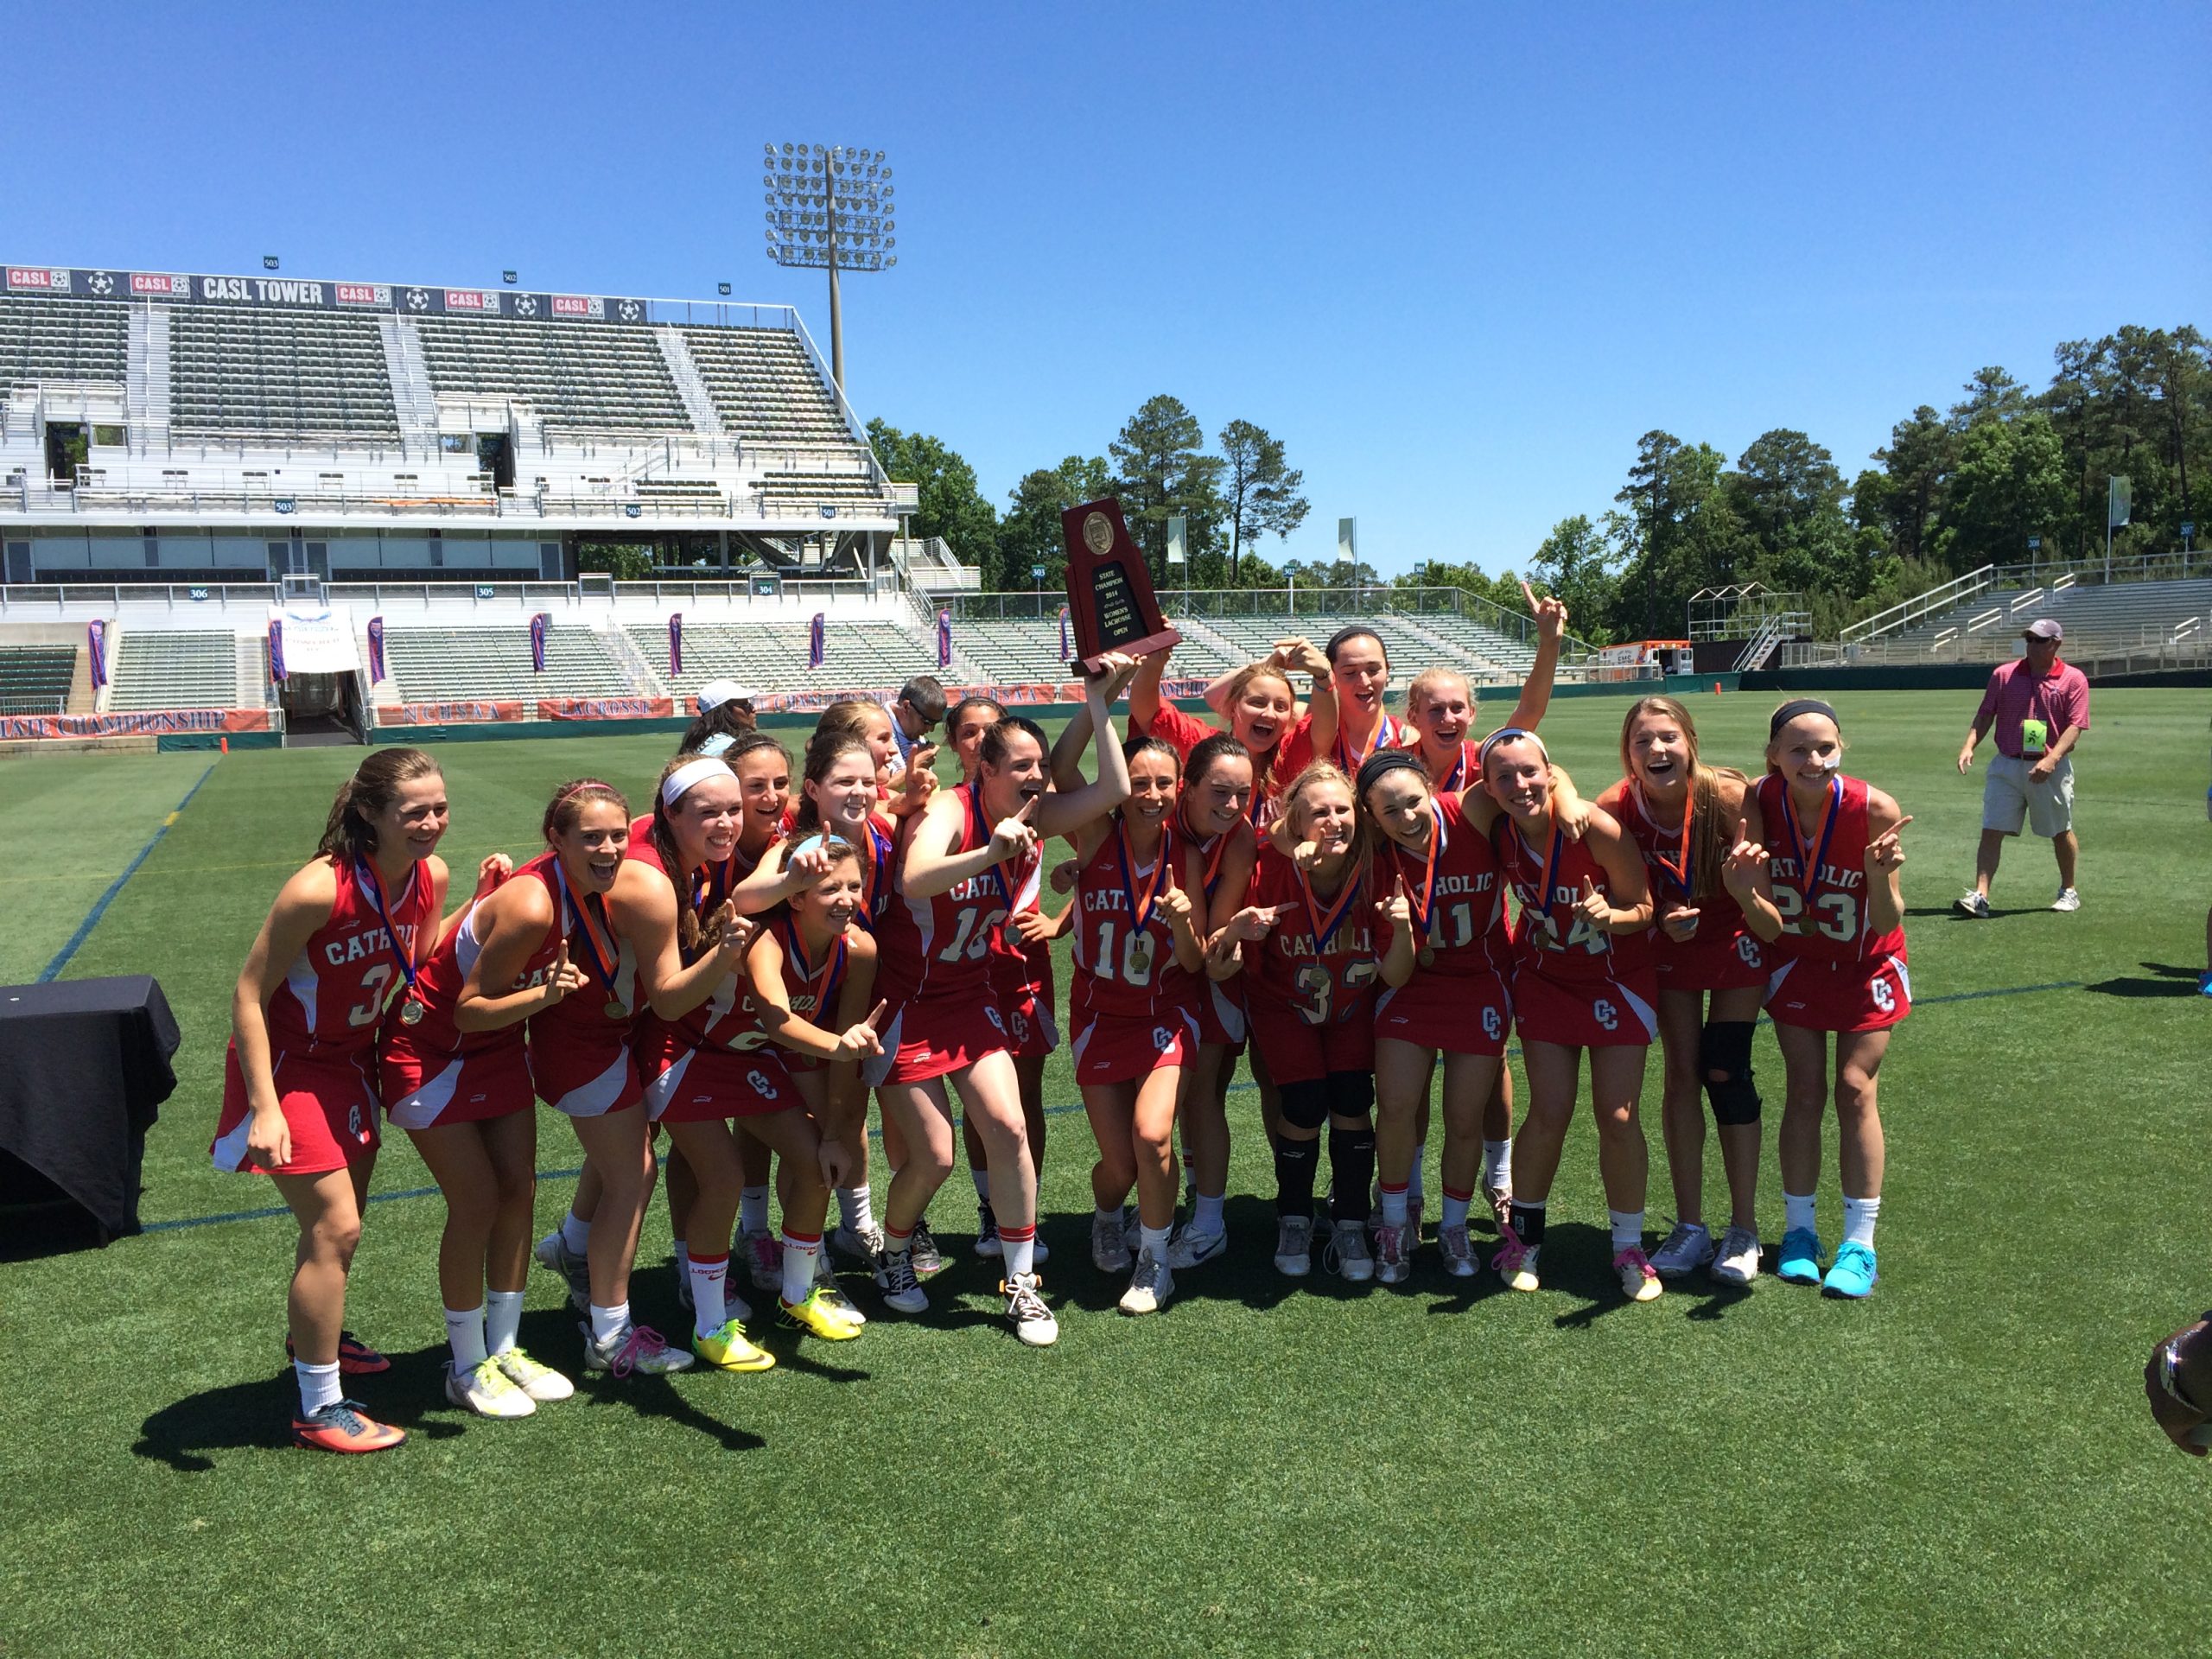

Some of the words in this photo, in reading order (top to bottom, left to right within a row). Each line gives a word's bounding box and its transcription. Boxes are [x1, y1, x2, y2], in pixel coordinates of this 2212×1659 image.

[264, 258, 278, 268] 503
[11, 270, 48, 285] CASL
[135, 276, 169, 290] CASL
[504, 274, 517, 283] 502
[203, 277, 252, 301] CASL
[255, 280, 323, 304] TOWER
[340, 287, 372, 301] CASL
[449, 293, 480, 306] CASL
[556, 299, 587, 312] CASL
[276, 502, 292, 512] 503
[626, 507, 641, 516] 502
[1033, 569, 1046, 577] 303
[1099, 569, 1116, 581] STATE
[759, 585, 772, 594] 304
[1095, 576, 1123, 591] CHAMPION
[189, 588, 208, 599] 306
[478, 587, 494, 597] 305
[1105, 589, 1118, 600] 2014
[1103, 613, 1132, 628] LACROSSE
[1113, 626, 1128, 637] OPEN
[403, 702, 501, 722] NCHSAA
[0, 718, 51, 738] TATE
[57, 709, 227, 737] CHAMPIONSHIP
[1771, 885, 1857, 942] 23
[1093, 921, 1154, 987] 10
[1738, 936, 1762, 969] CC
[348, 962, 392, 1027] 3
[1871, 977, 1896, 1013] CC
[1593, 999, 1618, 1030] CC
[1482, 1007, 1502, 1040] CC
[746, 1070, 778, 1100] CC
